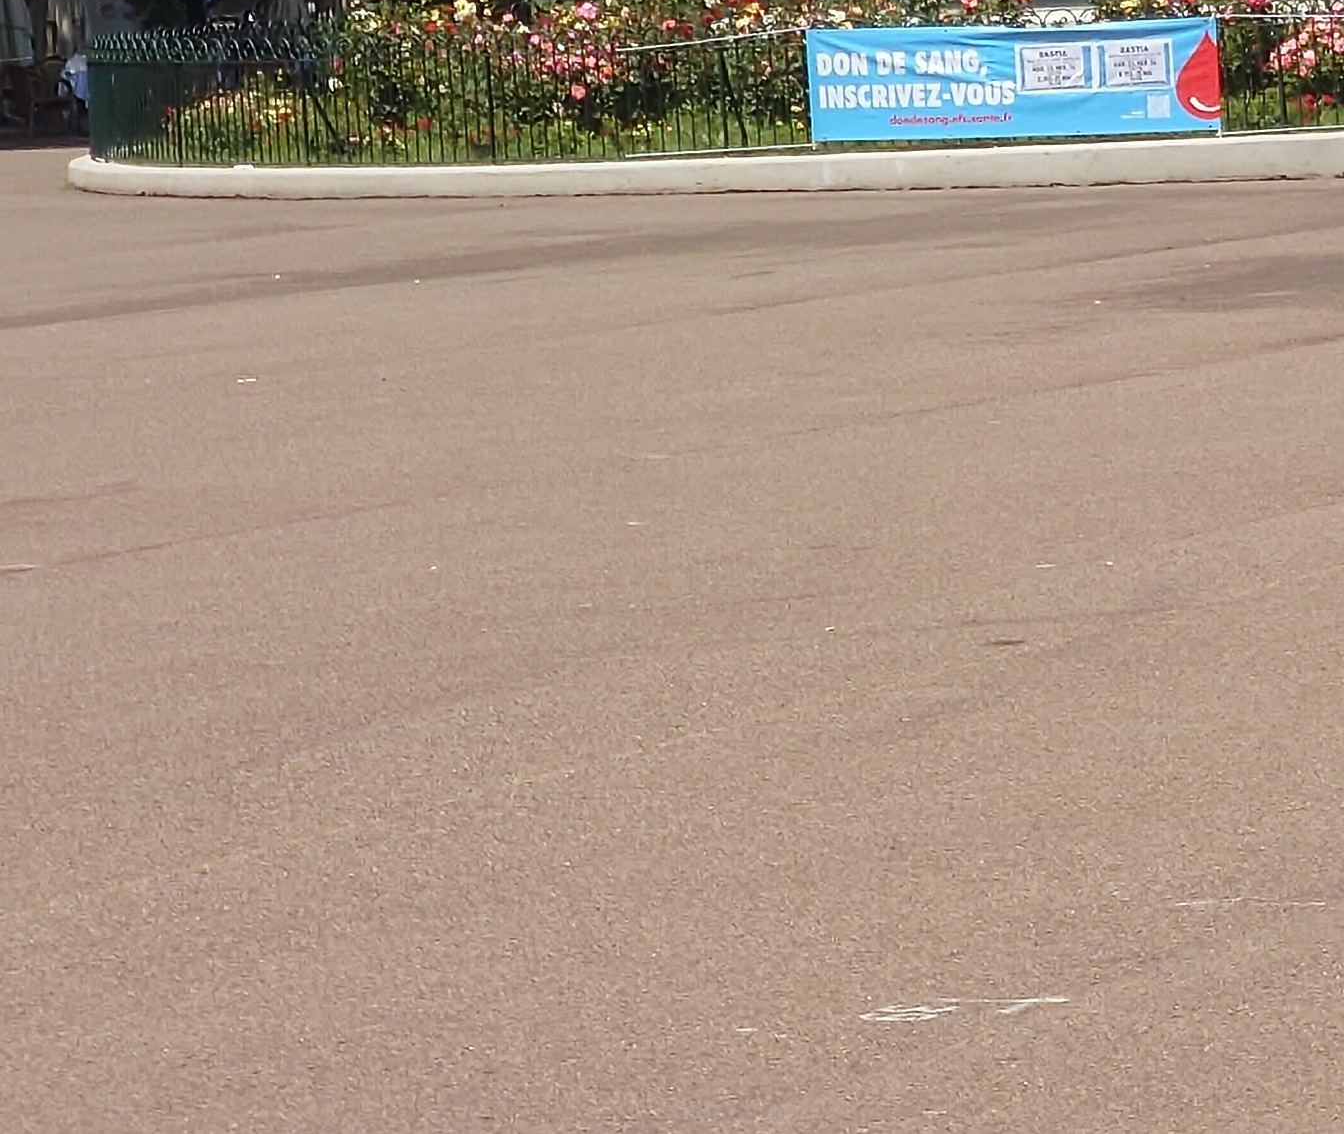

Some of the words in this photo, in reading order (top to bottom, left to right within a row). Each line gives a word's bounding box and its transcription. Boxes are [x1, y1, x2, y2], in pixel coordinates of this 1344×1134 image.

[816, 52, 869, 77] DON
[875, 50, 906, 76] DE
[914, 49, 988, 77] SANG,
[819, 80, 1016, 109] INSCRIVEZ-VOUS
